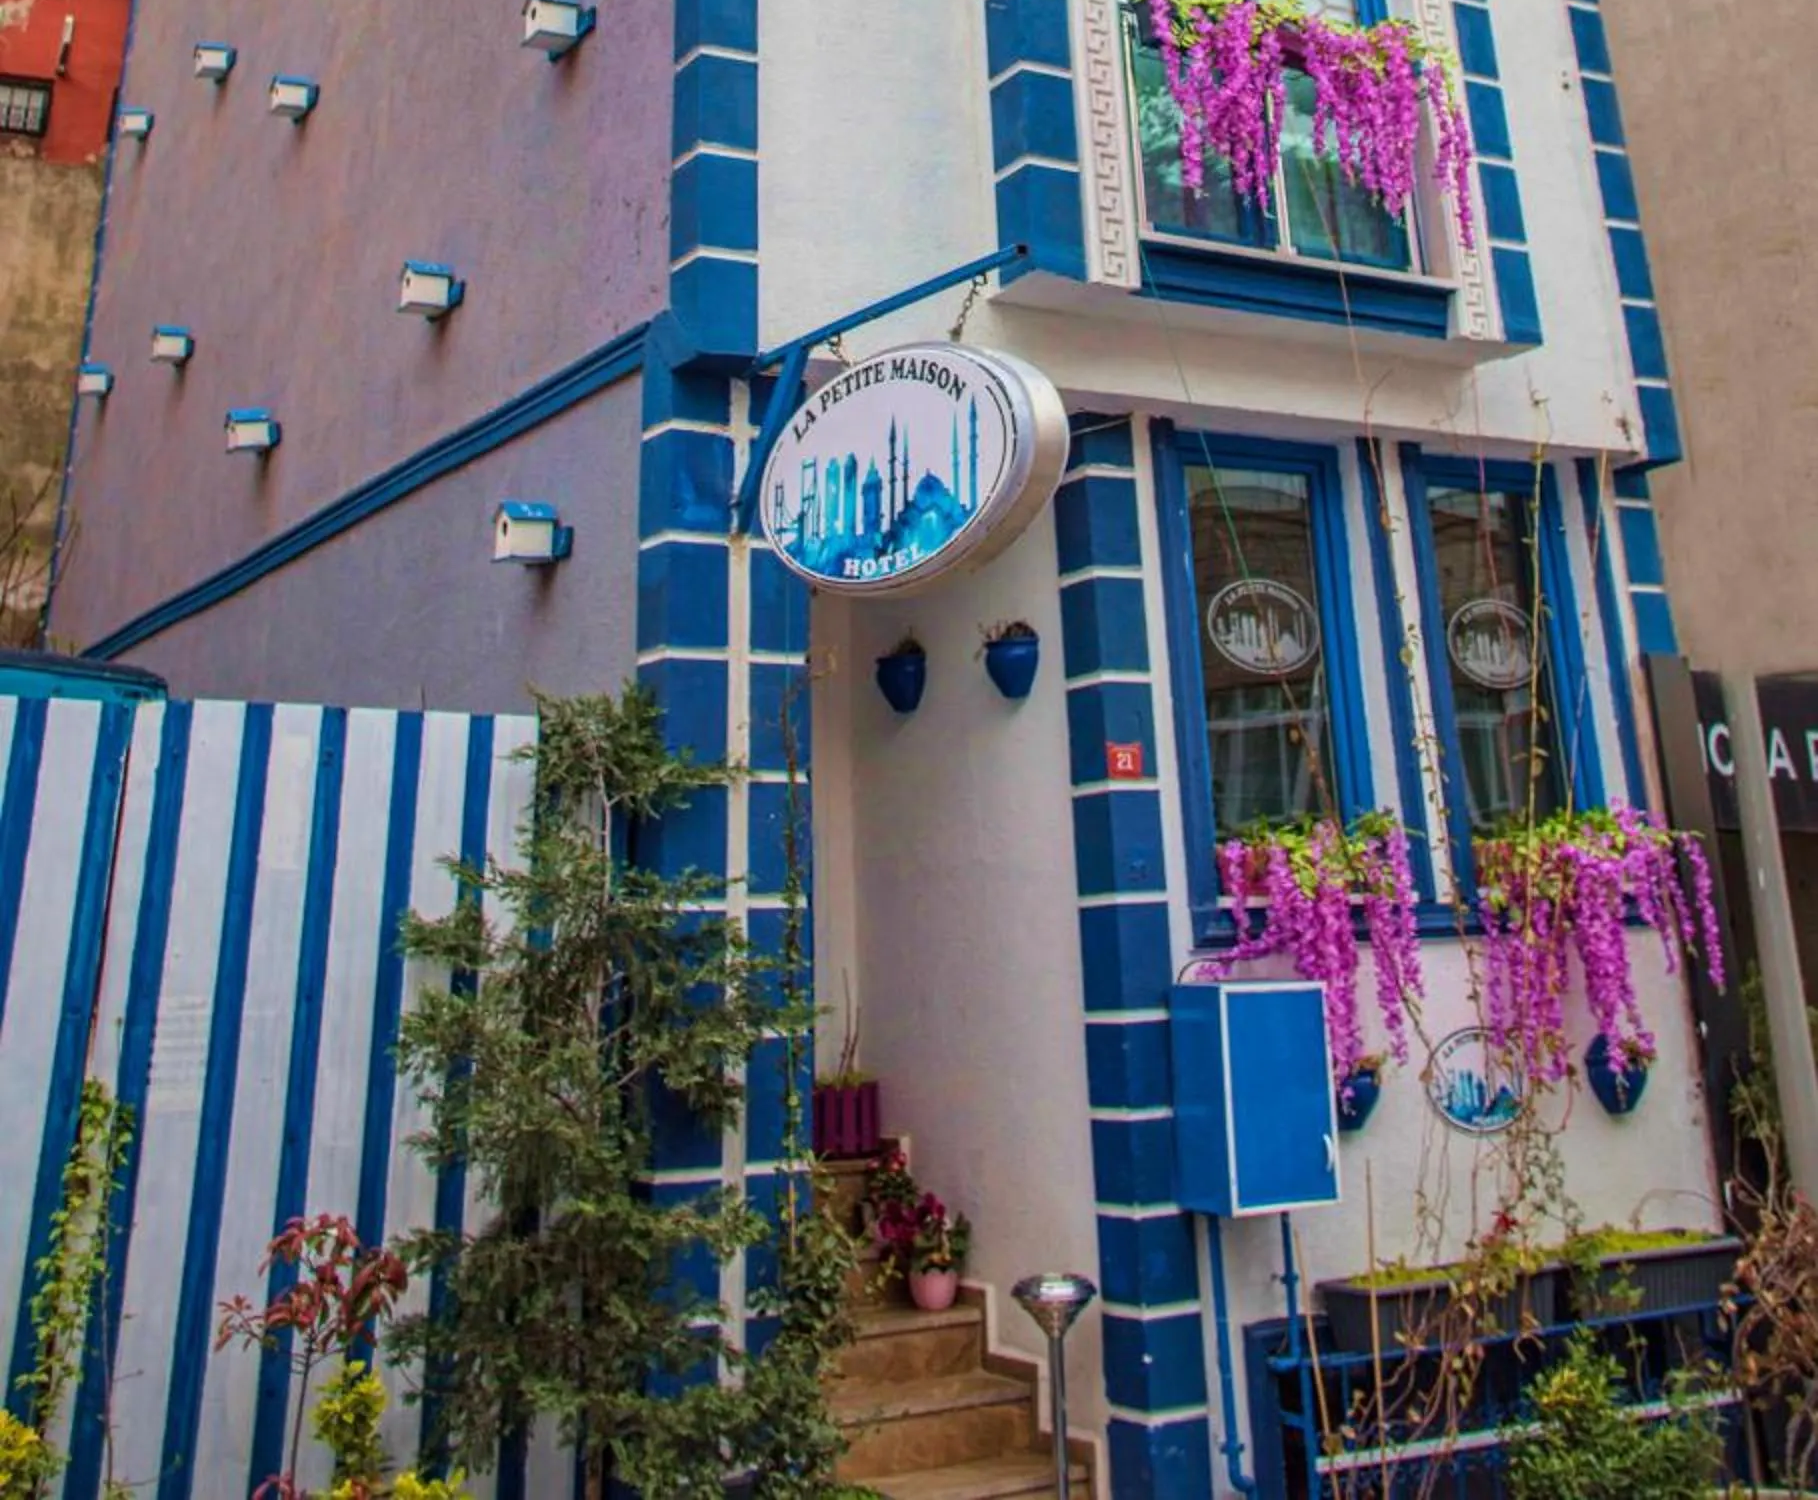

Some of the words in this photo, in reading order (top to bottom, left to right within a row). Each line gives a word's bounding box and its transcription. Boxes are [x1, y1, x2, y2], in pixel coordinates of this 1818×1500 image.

[793, 409, 817, 444] LA
[819, 361, 885, 414] PETITE
[891, 357, 967, 402] MAISON
[843, 545, 926, 577] HOTEL
